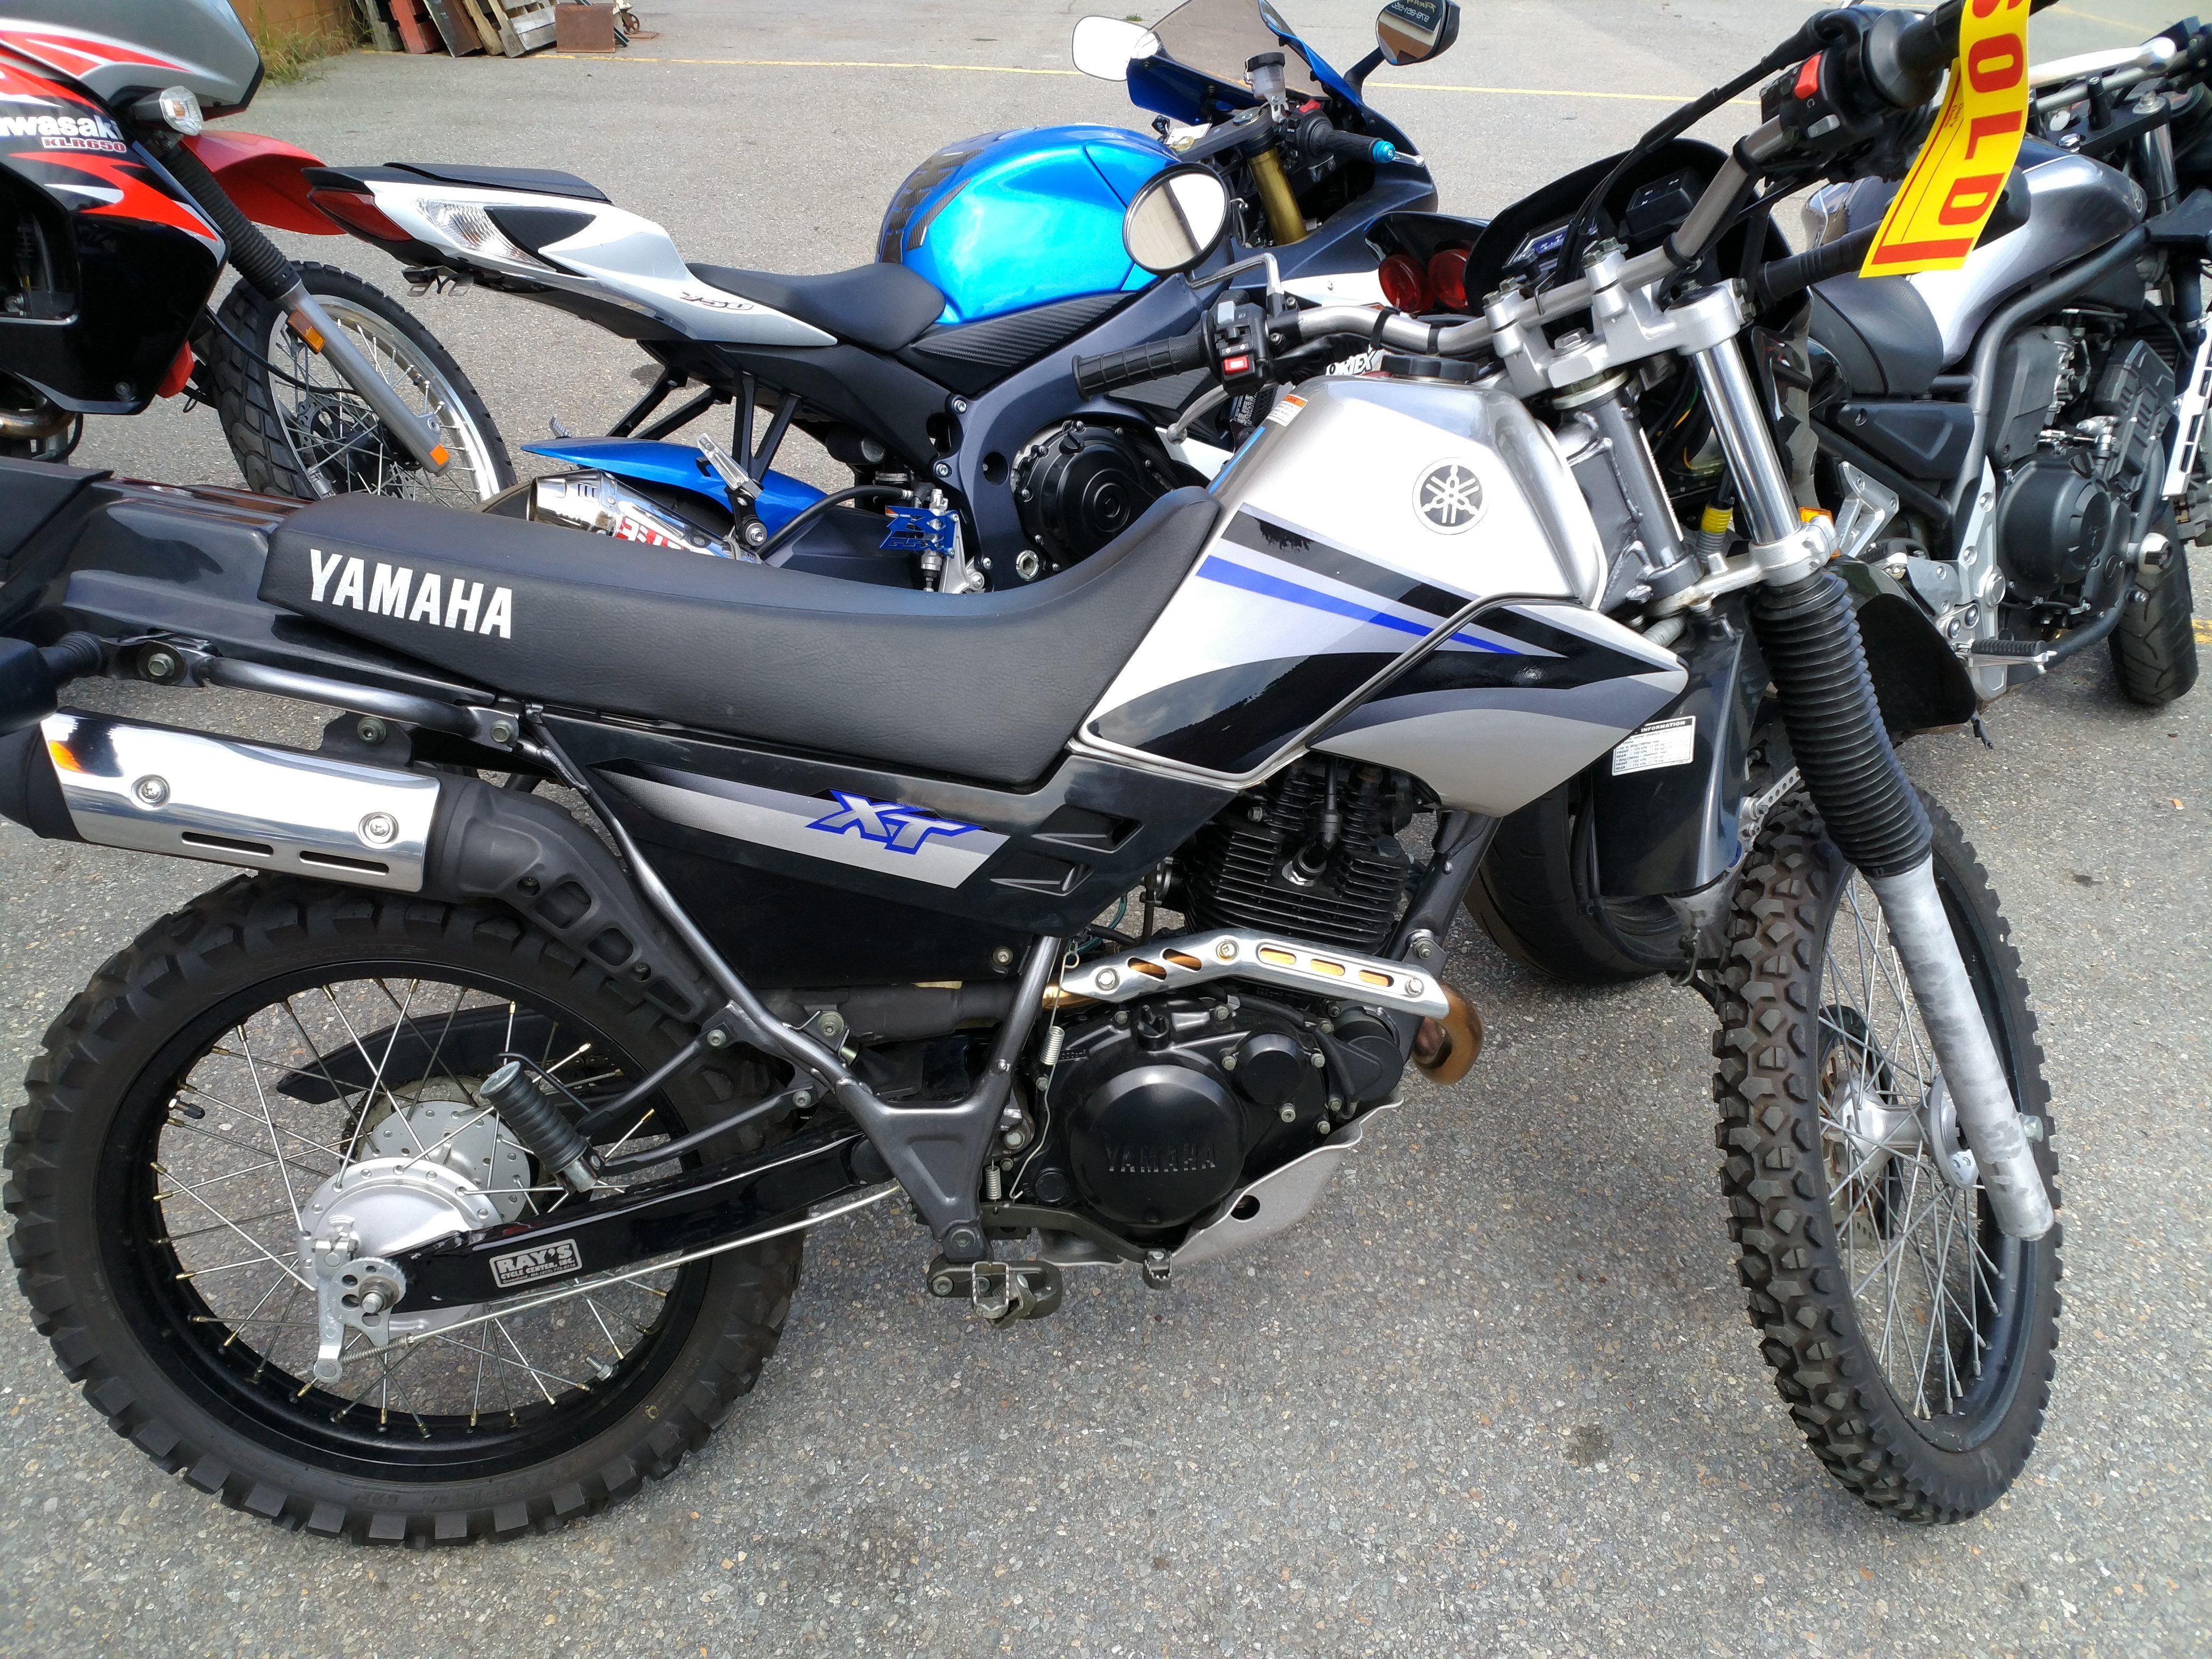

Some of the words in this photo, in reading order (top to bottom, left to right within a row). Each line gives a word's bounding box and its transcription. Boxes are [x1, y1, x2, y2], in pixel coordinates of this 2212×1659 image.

[42, 137, 127, 153] KLR650
[680, 291, 755, 311] 750
[309, 548, 513, 640] YAMAHA
[1640, 720, 1686, 733] INFORMATION
[805, 789, 985, 855] XT
[1105, 1143, 1217, 1173] YAMAHA
[496, 1244, 573, 1274] RAY'S
[500, 1269, 525, 1280] CYCLE
